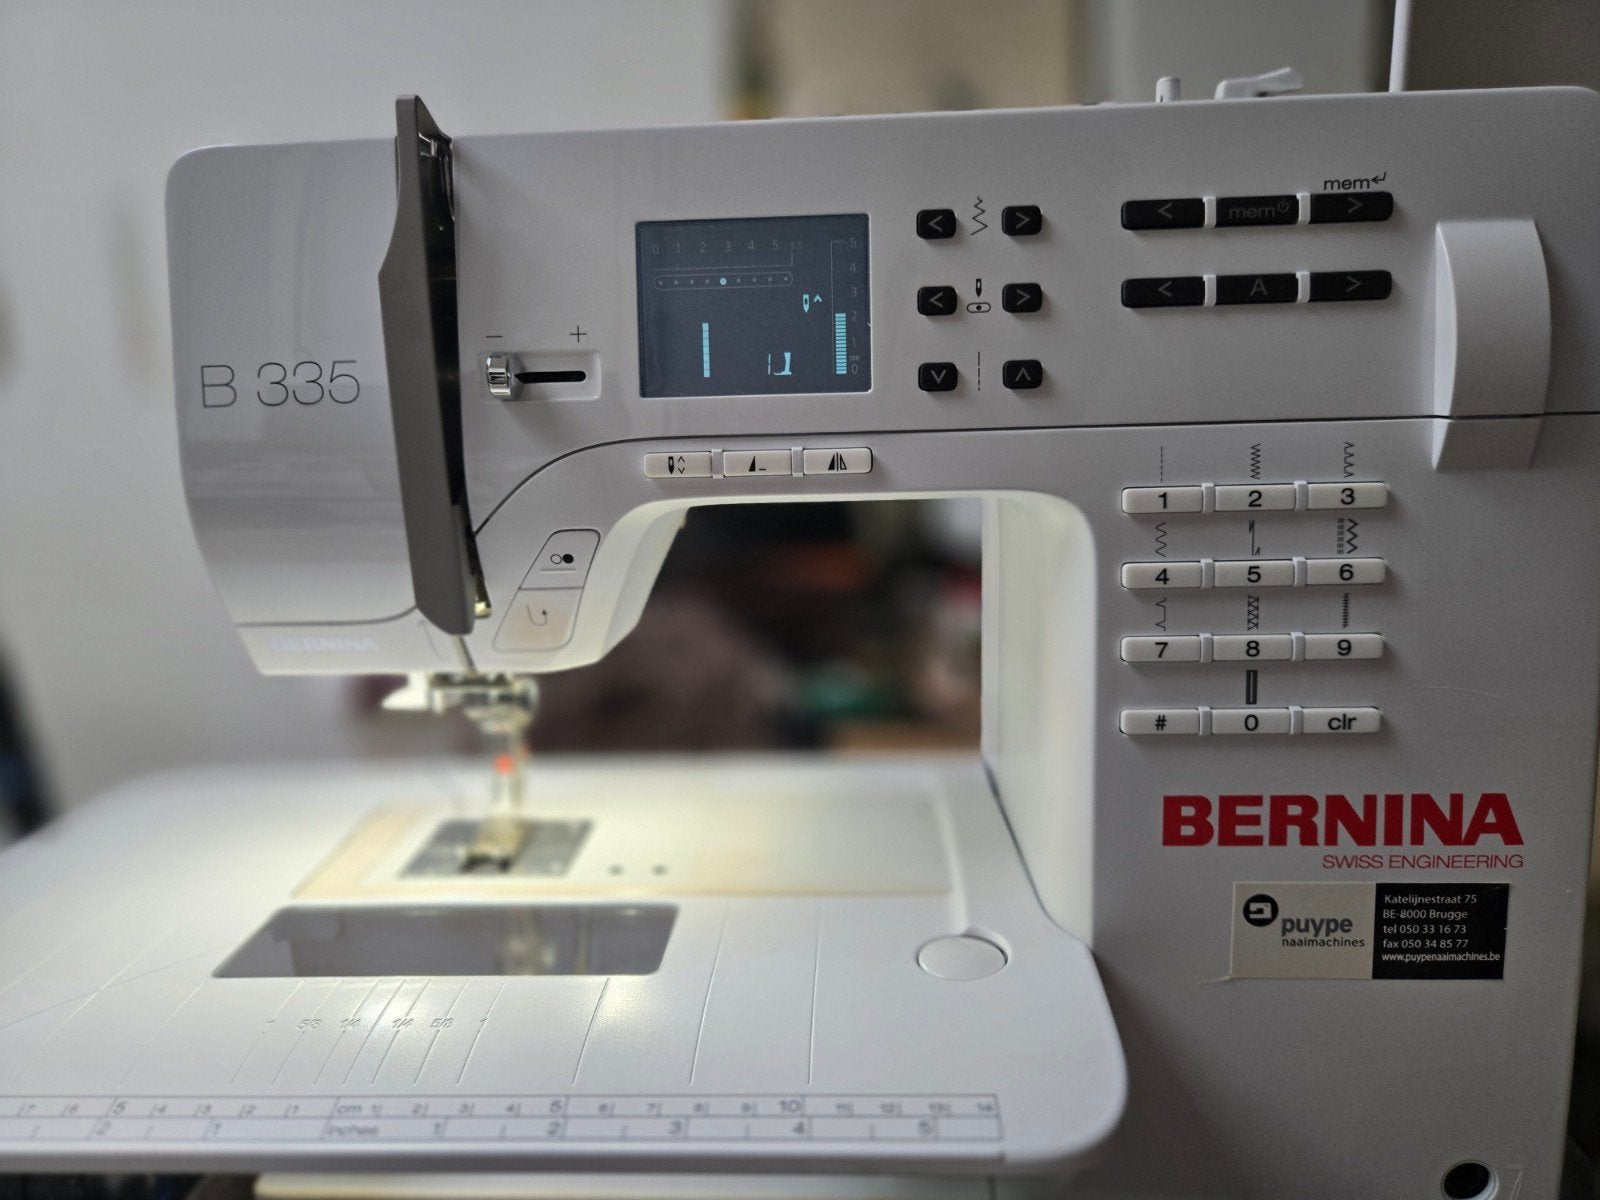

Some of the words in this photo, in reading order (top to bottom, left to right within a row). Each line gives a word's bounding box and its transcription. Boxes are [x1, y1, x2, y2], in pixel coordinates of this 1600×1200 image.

[1323, 178, 1370, 190] mem
[1229, 205, 1275, 220] mem
[652, 244, 660, 253] 0
[700, 243, 706, 252] 2
[725, 242, 731, 251] 3
[748, 241, 754, 250] 4
[772, 240, 778, 250] 5
[850, 236, 857, 248] 5
[849, 262, 857, 273] 4
[850, 287, 857, 298] 3
[1250, 277, 1267, 296] A
[851, 311, 857, 322] 2
[851, 363, 858, 374] 0
[201, 364, 237, 408] B
[257, 359, 361, 407] 335
[1158, 492, 1168, 509] 1
[1248, 490, 1262, 507] 2
[1340, 488, 1355, 505] 3
[1155, 568, 1169, 585] 4
[1247, 566, 1261, 583] 5
[1339, 563, 1354, 581] 6
[1155, 641, 1168, 658] 7
[1245, 640, 1260, 657] 8
[1337, 639, 1351, 656] 9
[1155, 714, 1167, 731] #
[1244, 714, 1259, 731] 0
[1327, 712, 1357, 731] clr
[1162, 793, 1524, 846] BERNINA
[1322, 854, 1383, 869] SWISS
[1389, 854, 1524, 869] ENGINEERING
[1384, 894, 1461, 906] Katelijnestraat
[1464, 894, 1477, 904] 75
[1382, 909, 1427, 919] BE-8000
[1429, 909, 1468, 920] Brugge
[1281, 915, 1353, 937] puype
[1383, 924, 1397, 934] tel
[1399, 925, 1419, 934] 050
[1422, 925, 1435, 934] 33
[1439, 925, 1451, 934] 16
[1454, 925, 1467, 934] 73
[1281, 937, 1365, 948] naaimachines
[1382, 939, 1399, 949] fax
[1401, 939, 1421, 949] 050
[1425, 939, 1437, 949] 34
[1439, 939, 1453, 949] 85
[1456, 939, 1468, 949] 77
[1381, 951, 1500, 963] www.puypenaaimachines.be
[113, 1100, 128, 1115] 5
[201, 1104, 212, 1115] 3
[245, 1104, 257, 1115] 2
[337, 1104, 363, 1115] cm
[412, 1103, 423, 1114] 2
[459, 1103, 469, 1114] 3
[505, 1103, 515, 1113] 4
[549, 1100, 561, 1113] 5
[780, 1099, 800, 1113] 10
